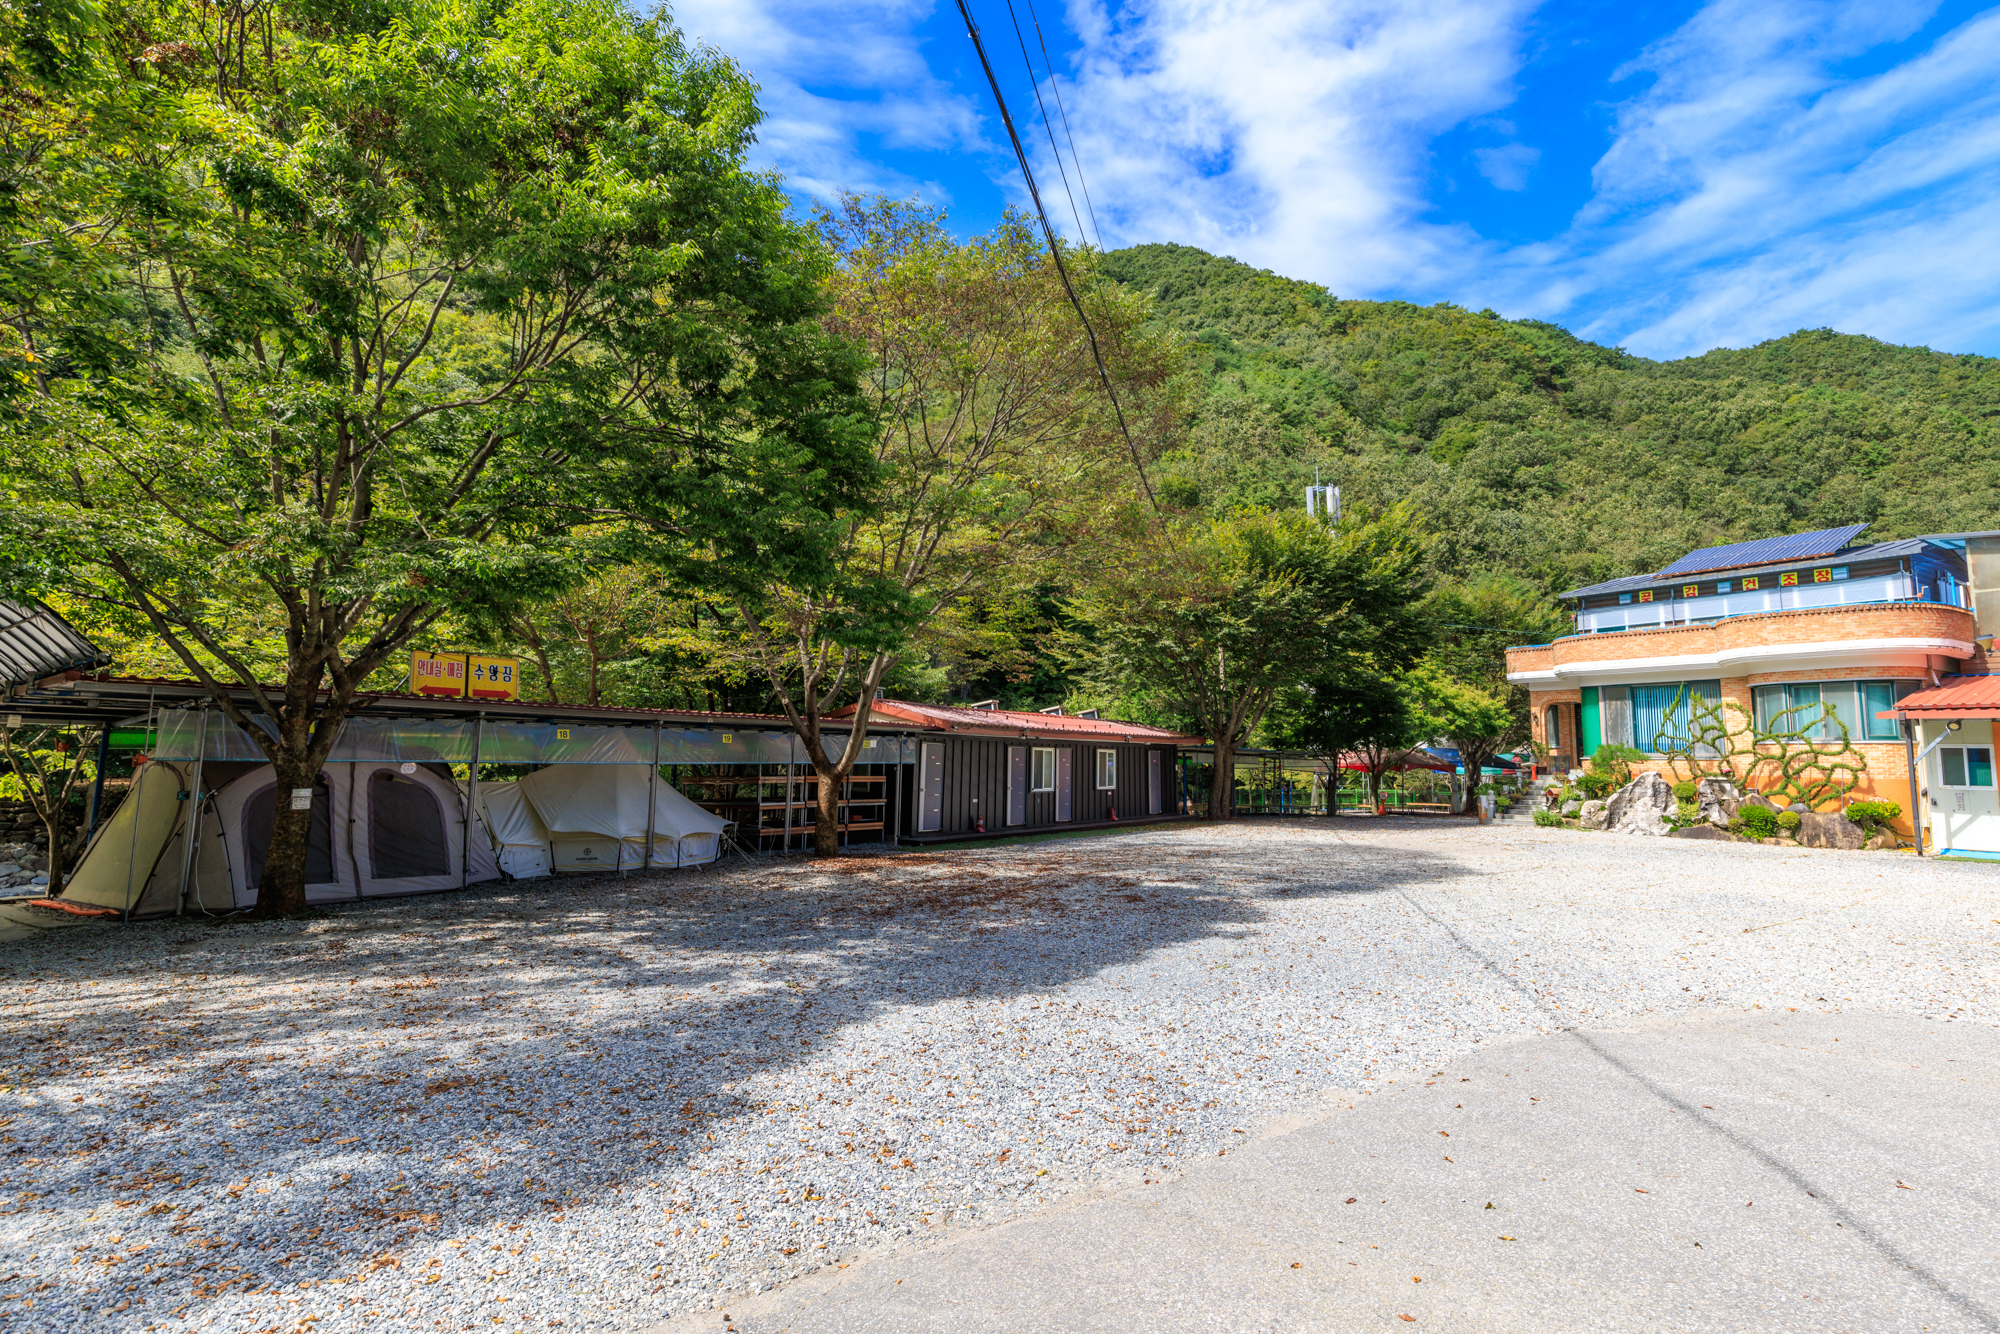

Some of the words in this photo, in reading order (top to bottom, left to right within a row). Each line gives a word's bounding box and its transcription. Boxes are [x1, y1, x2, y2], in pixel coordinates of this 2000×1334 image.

[474, 663, 513, 682] 수영장
[558, 730, 569, 739] 18
[723, 735, 731, 743] 19
